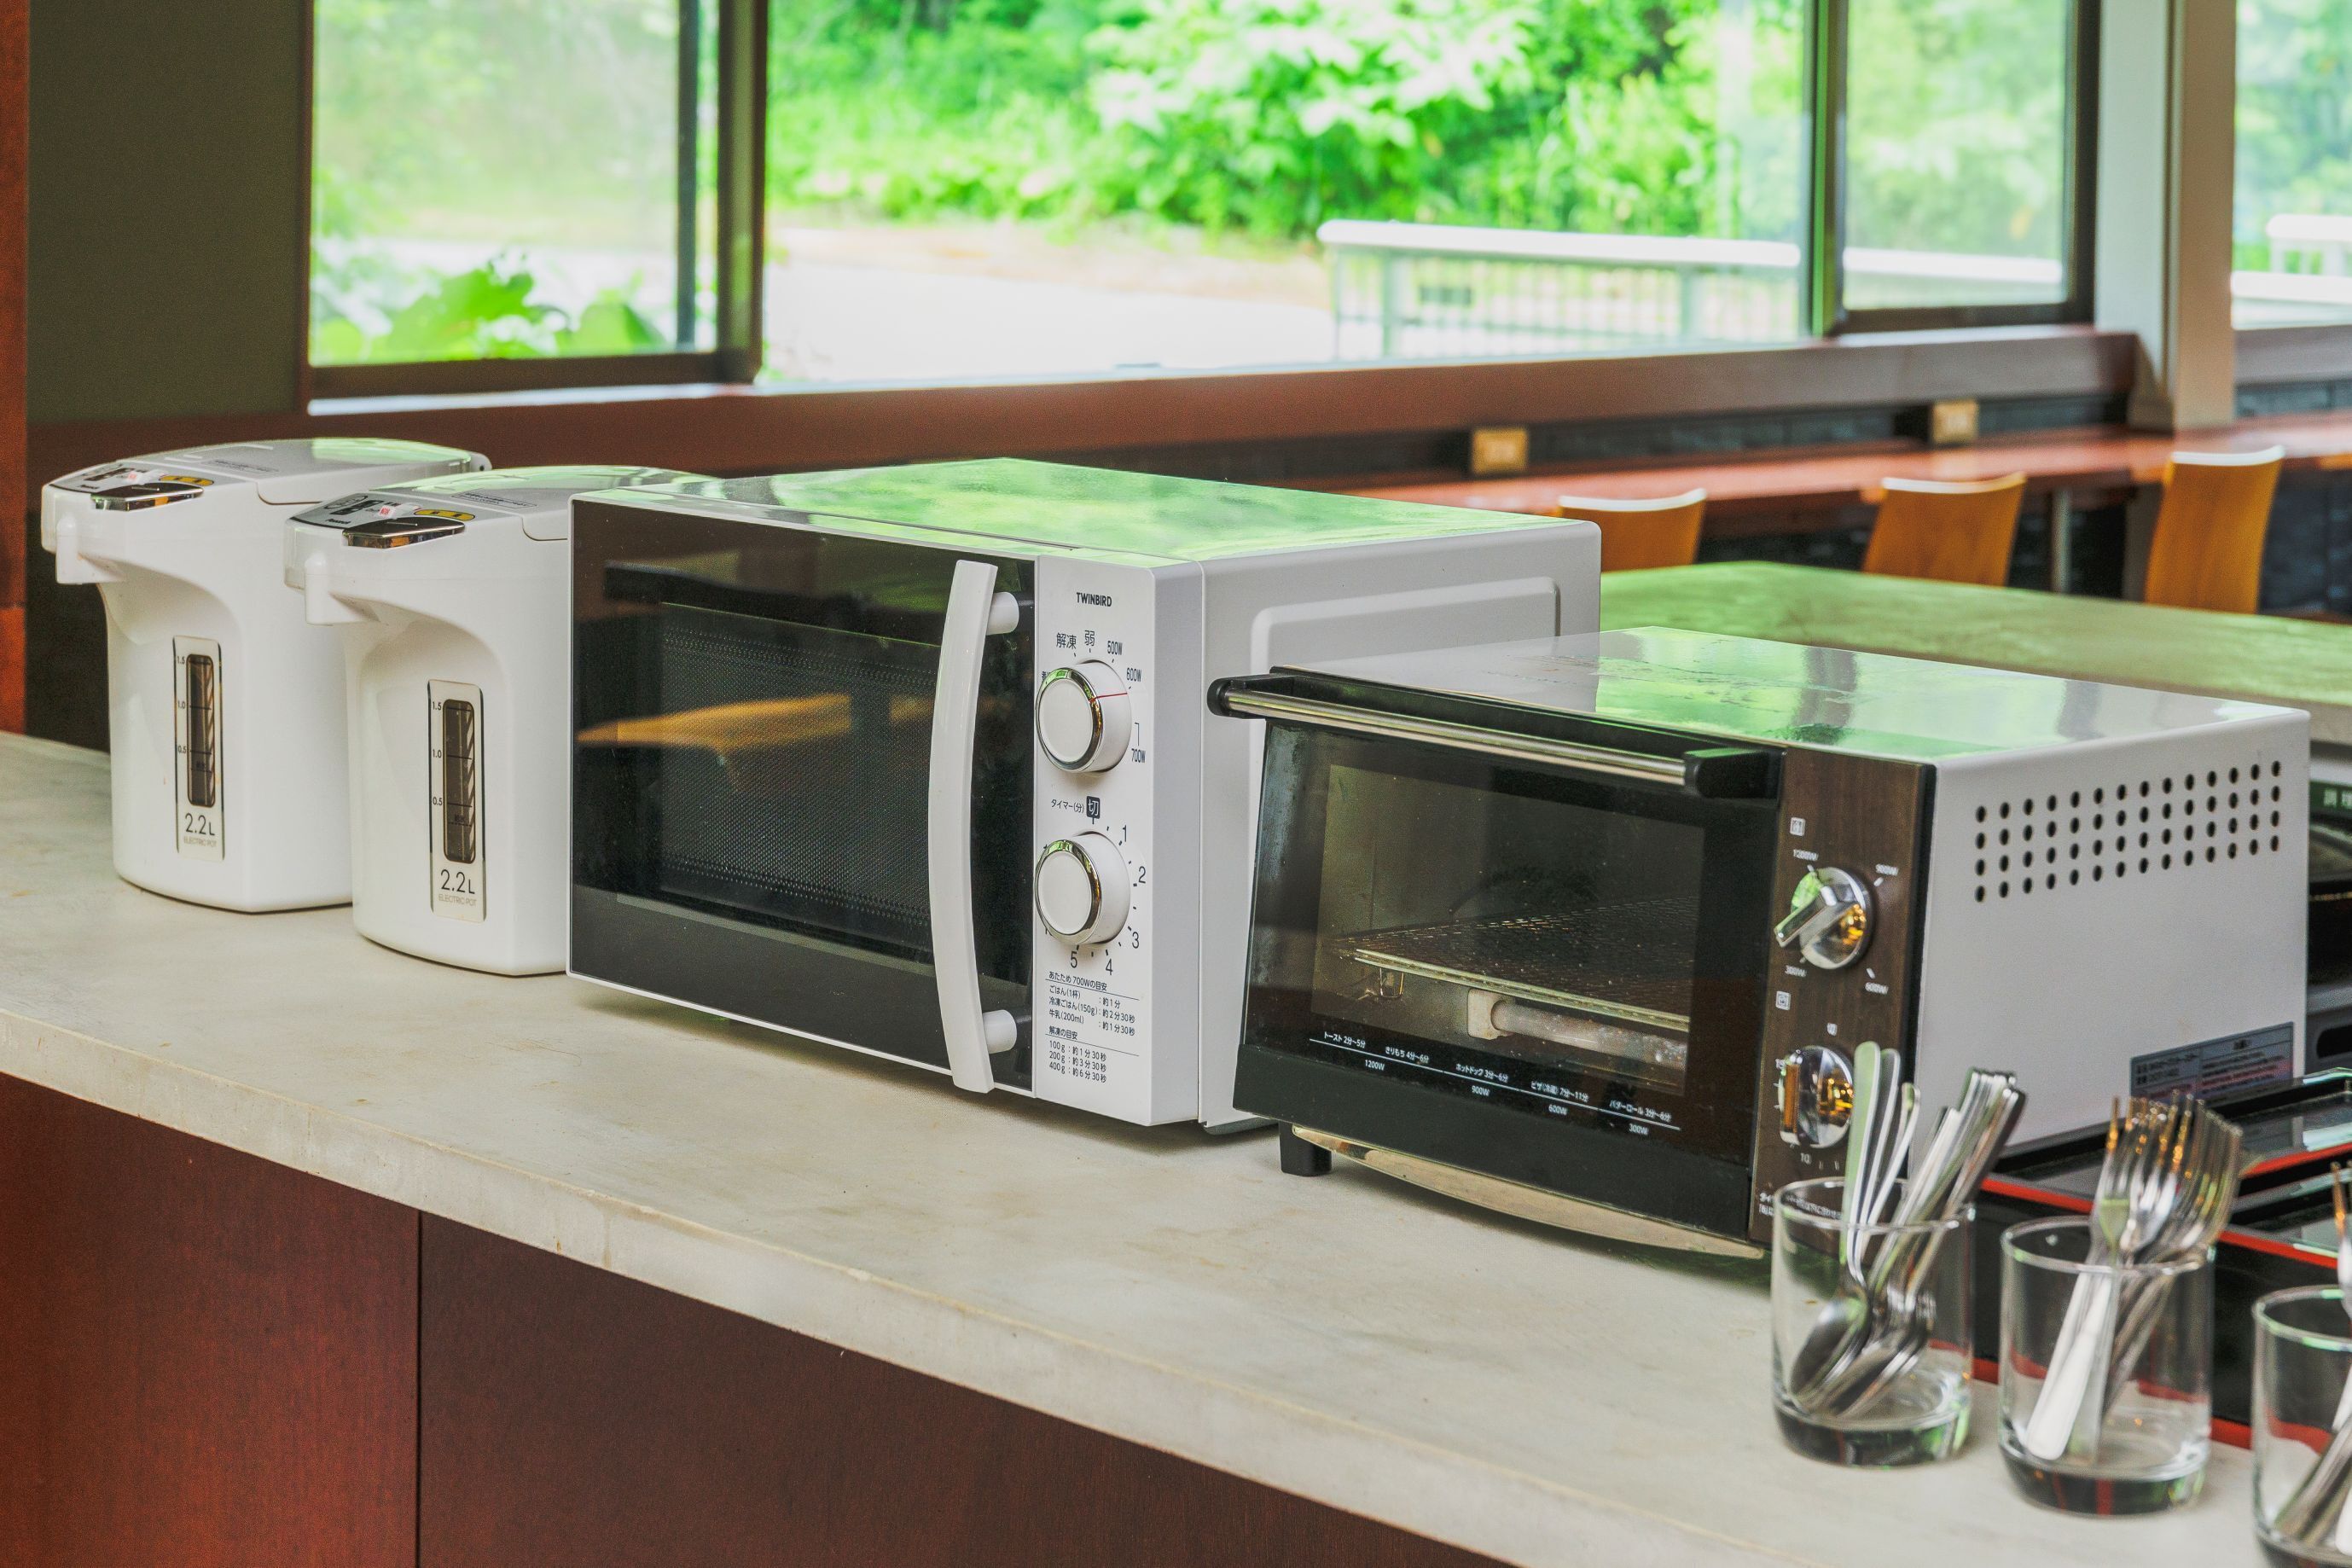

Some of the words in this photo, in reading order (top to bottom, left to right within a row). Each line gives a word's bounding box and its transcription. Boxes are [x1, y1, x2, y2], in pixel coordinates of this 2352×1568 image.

[1077, 592, 1112, 607] TWINBIRD
[1056, 632, 1077, 649] 解凍
[1084, 630, 1095, 647] 弱
[1107, 640, 1123, 656] 500W
[177, 656, 185, 665] 1.5
[1126, 667, 1142, 682] 600W
[177, 700, 186, 710] 1.0
[433, 701, 442, 711] 1.5
[177, 745, 187, 754] 0.5
[433, 749, 442, 758] 1.0
[1131, 748, 1146, 764] 700W
[433, 796, 443, 806] 0.5
[1051, 799, 1084, 814] タイマー(分)
[1088, 799, 1099, 816] 切
[185, 812, 216, 836] 2.2L
[1122, 824, 1127, 843] 1
[440, 868, 475, 895] 2.2L
[1138, 865, 1146, 885] 2
[1131, 931, 1140, 950] 3
[1070, 950, 1078, 969] 5
[1105, 958, 1113, 976] 4
[1049, 971, 1071, 984] あたため
[1072, 976, 1107, 991] 700Wの目安
[1049, 1025, 1078, 1041] 解凍の目安
[1324, 1031, 1342, 1042] トースト
[1385, 1046, 1405, 1058] きりもち
[1365, 1059, 1385, 1071] 1200W
[1472, 1085, 1491, 1097] 900W
